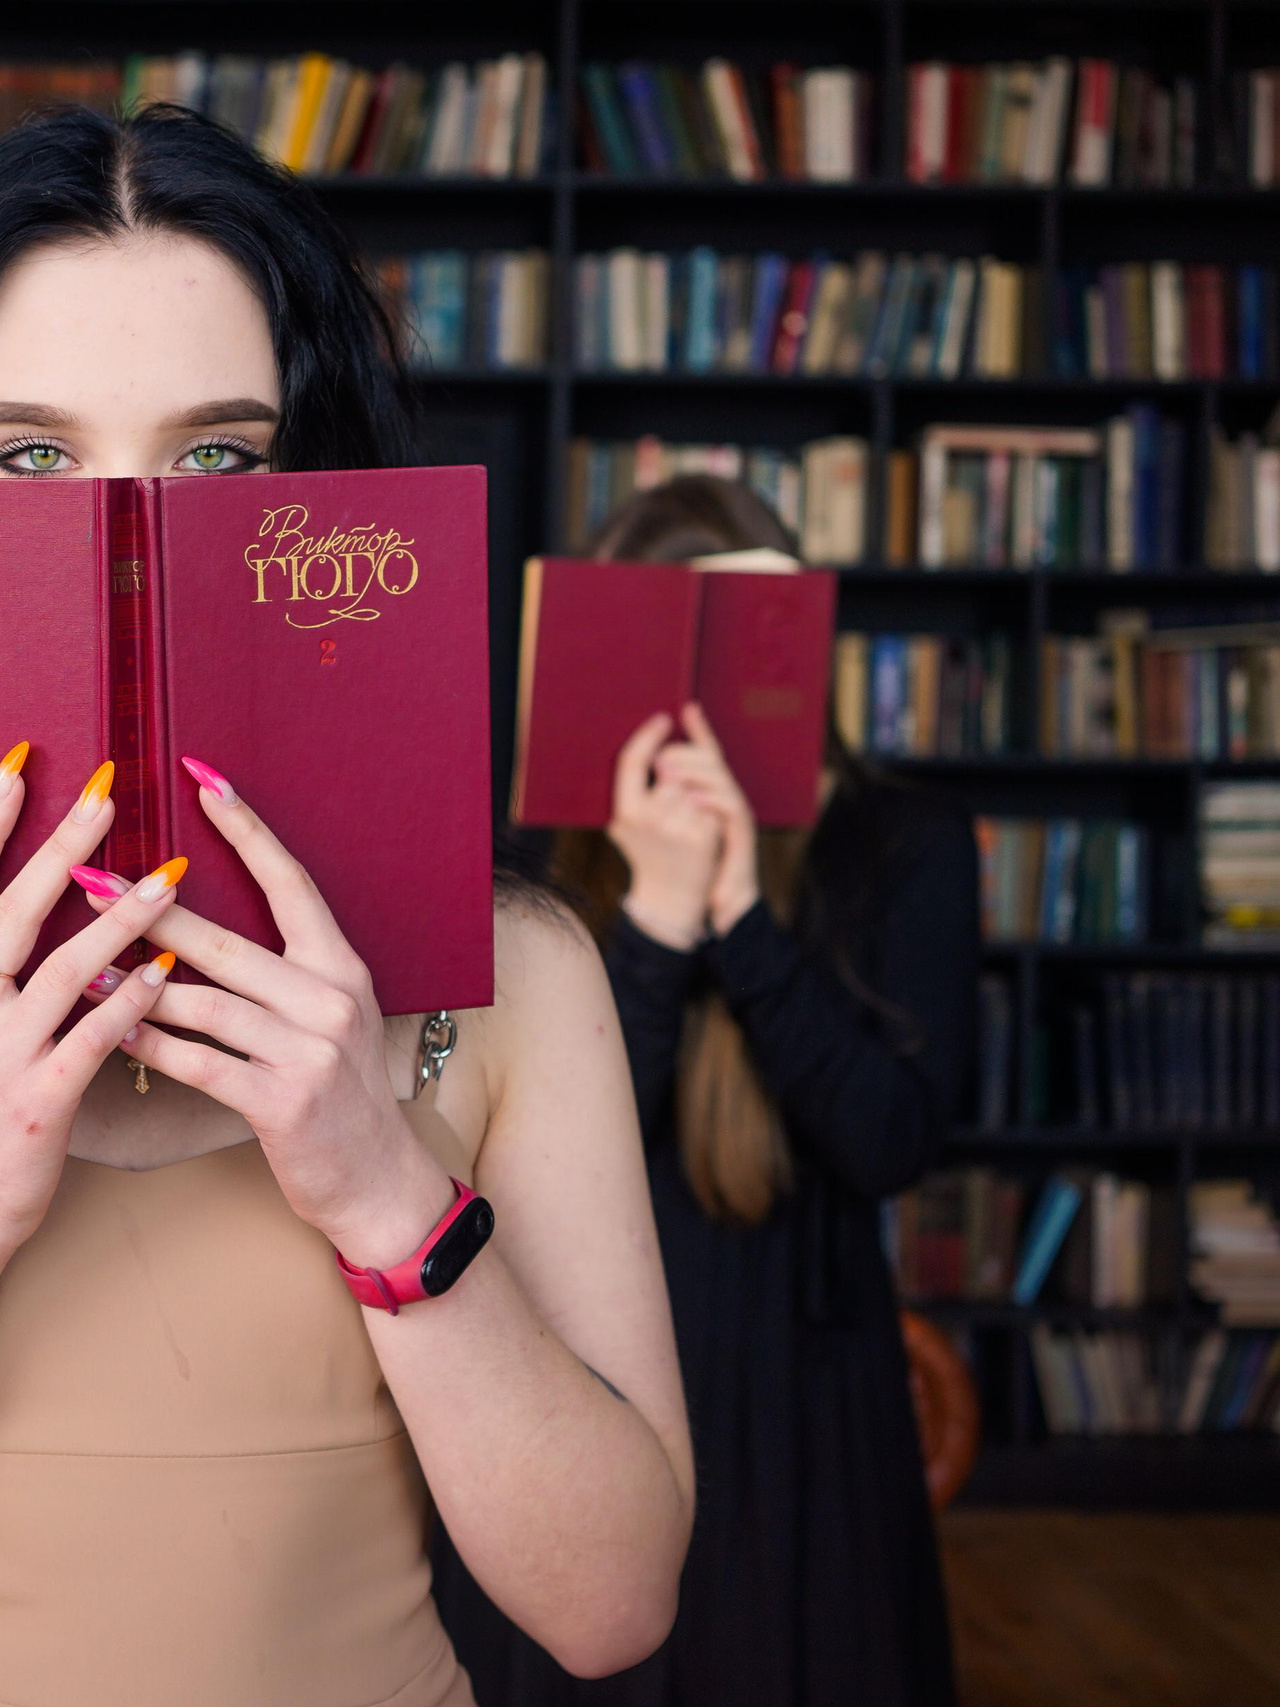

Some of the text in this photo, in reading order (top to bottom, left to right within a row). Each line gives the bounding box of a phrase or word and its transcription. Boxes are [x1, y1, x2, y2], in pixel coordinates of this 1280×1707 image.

[245, 504, 414, 568] Виктор
[250, 549, 419, 603] ГЮГО
[320, 639, 337, 665] 2
